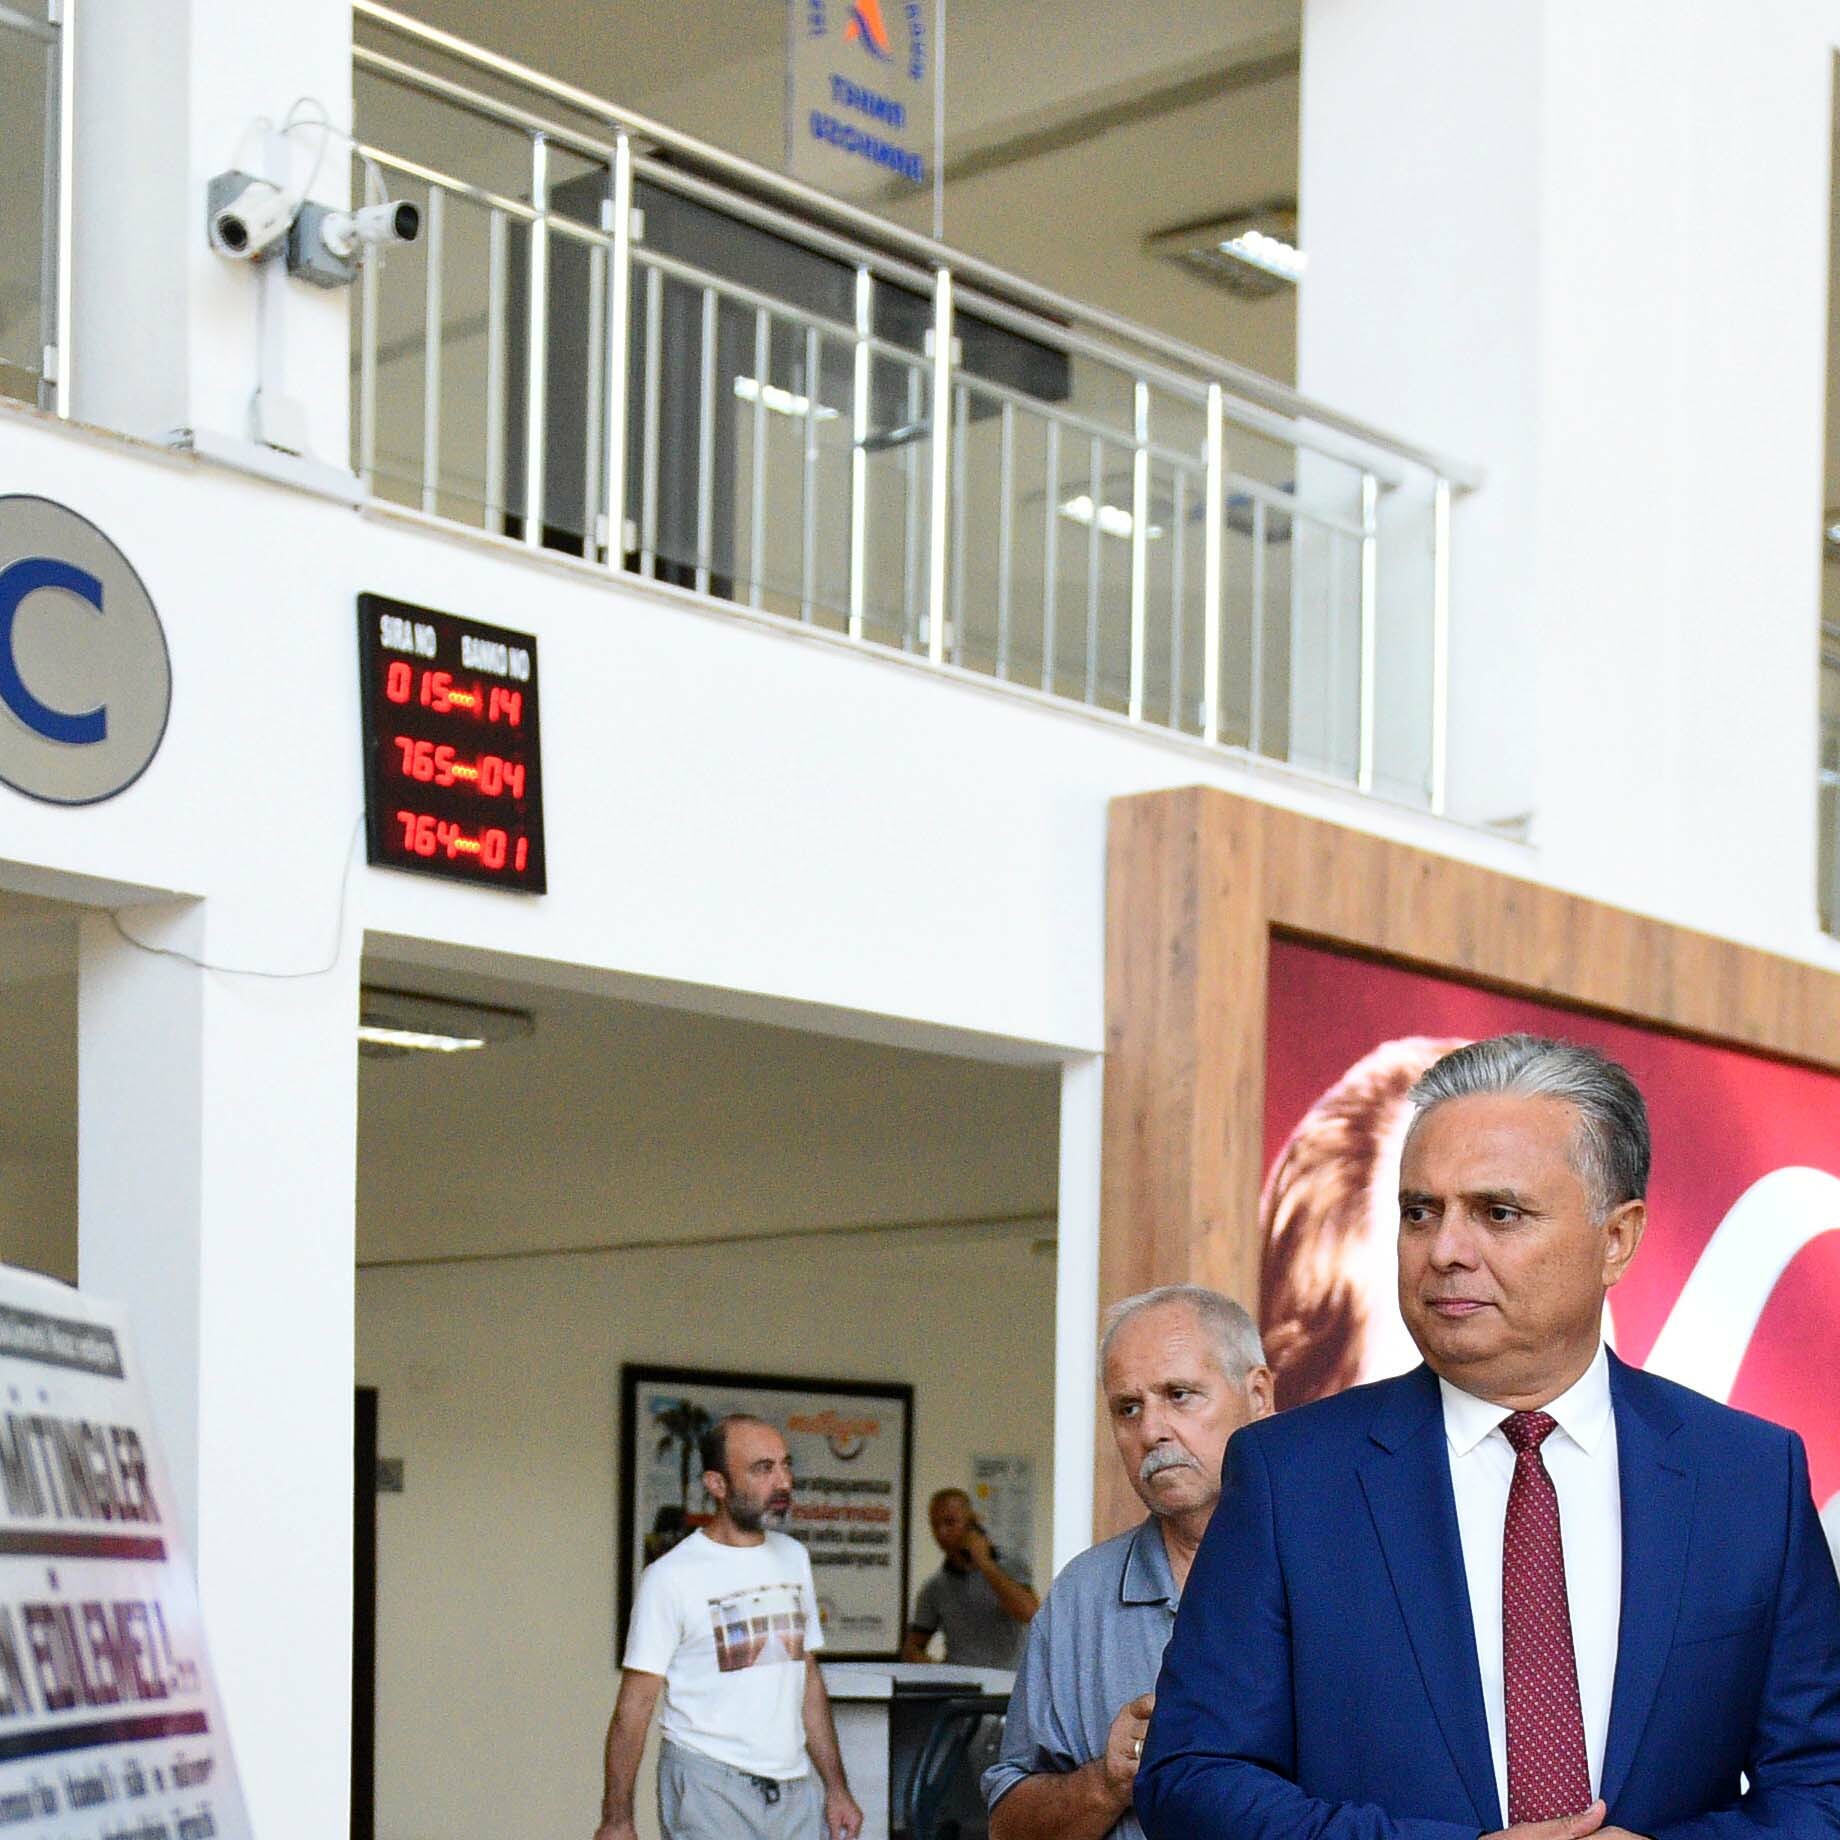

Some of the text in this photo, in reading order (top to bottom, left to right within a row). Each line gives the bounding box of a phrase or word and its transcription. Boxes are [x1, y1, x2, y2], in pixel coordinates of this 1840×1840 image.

[379, 613, 438, 660] SIRA NO
[509, 646, 531, 683] NO
